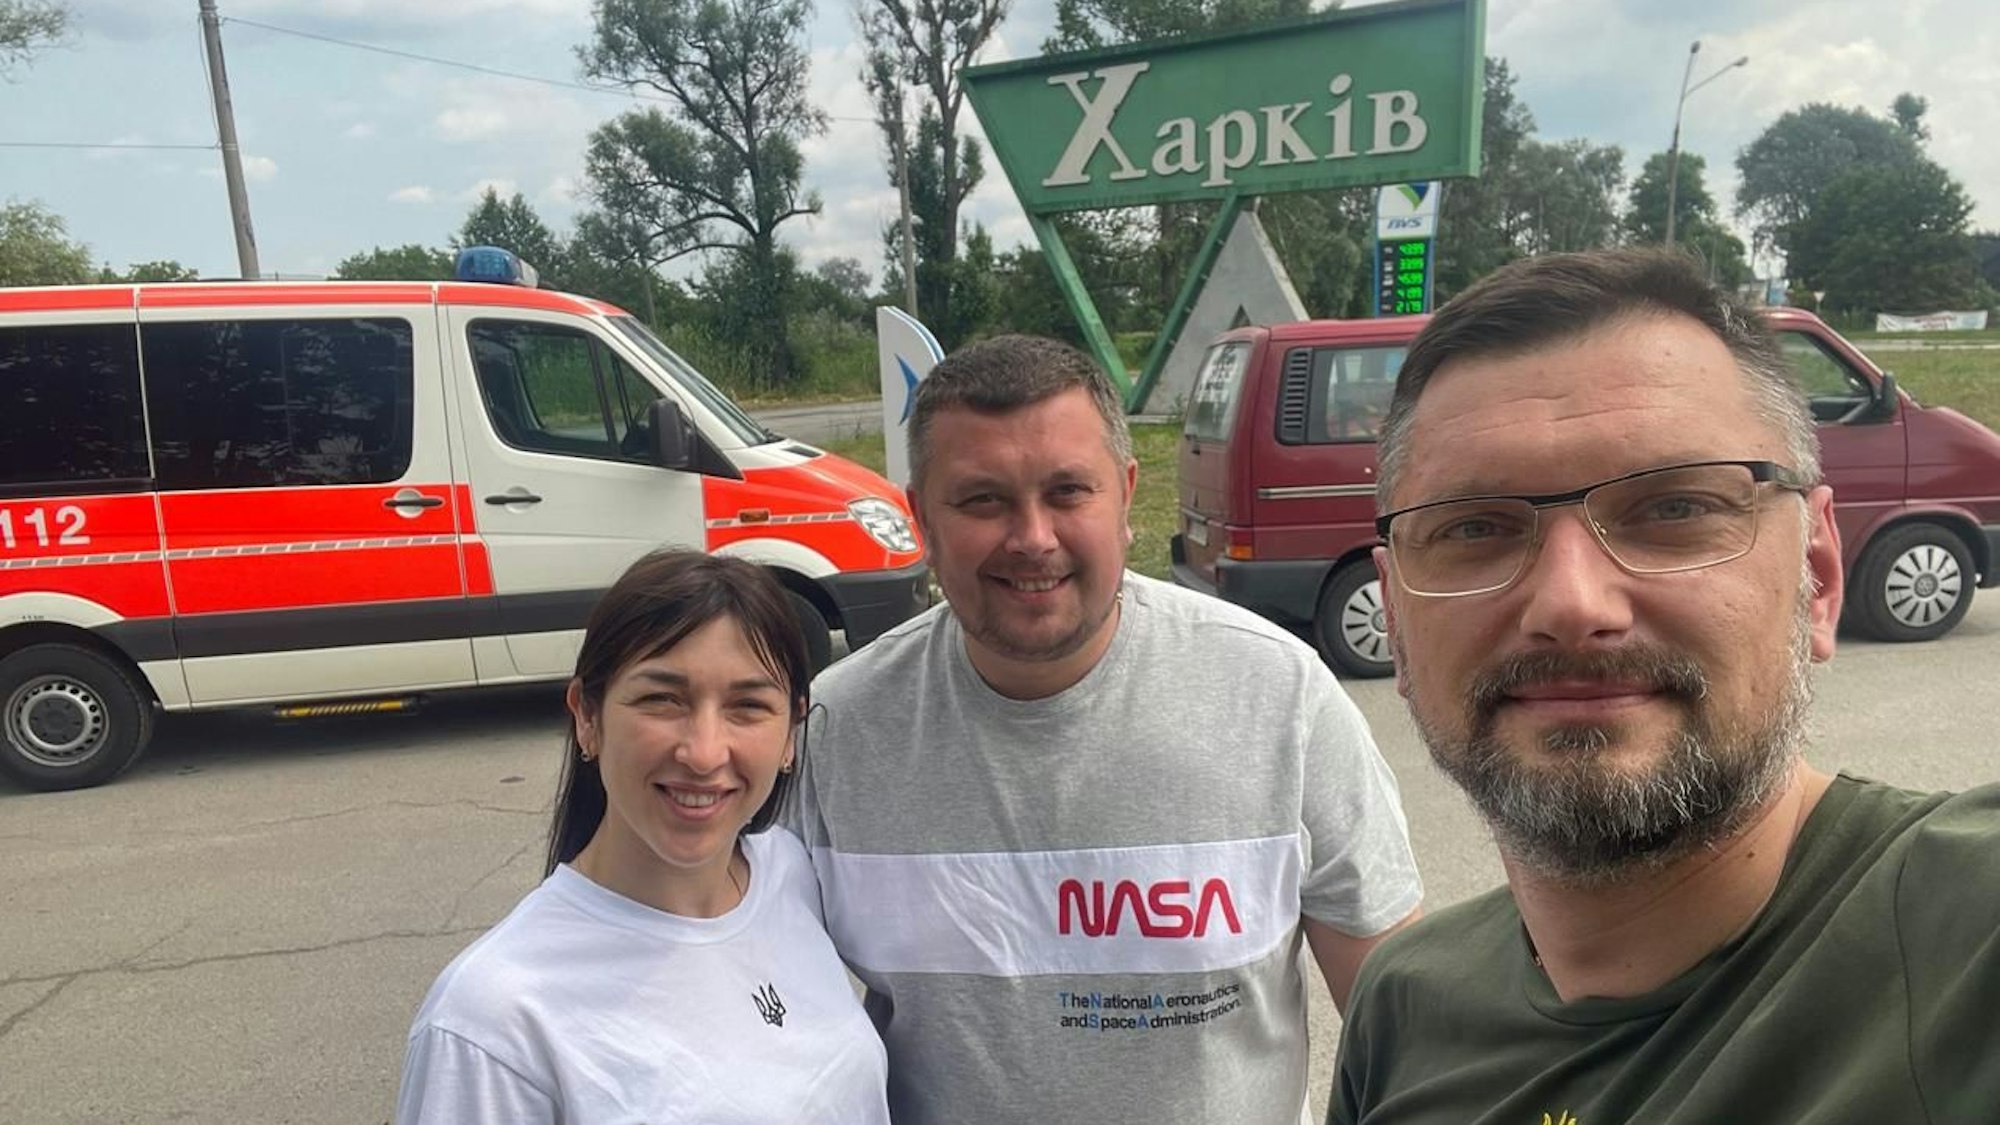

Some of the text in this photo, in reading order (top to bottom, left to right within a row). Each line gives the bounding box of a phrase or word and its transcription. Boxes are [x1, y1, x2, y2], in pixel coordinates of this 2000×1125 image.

[1041, 61, 1428, 188] Харків
[0, 505, 91, 548] 112
[1058, 878, 1242, 938] NASA
